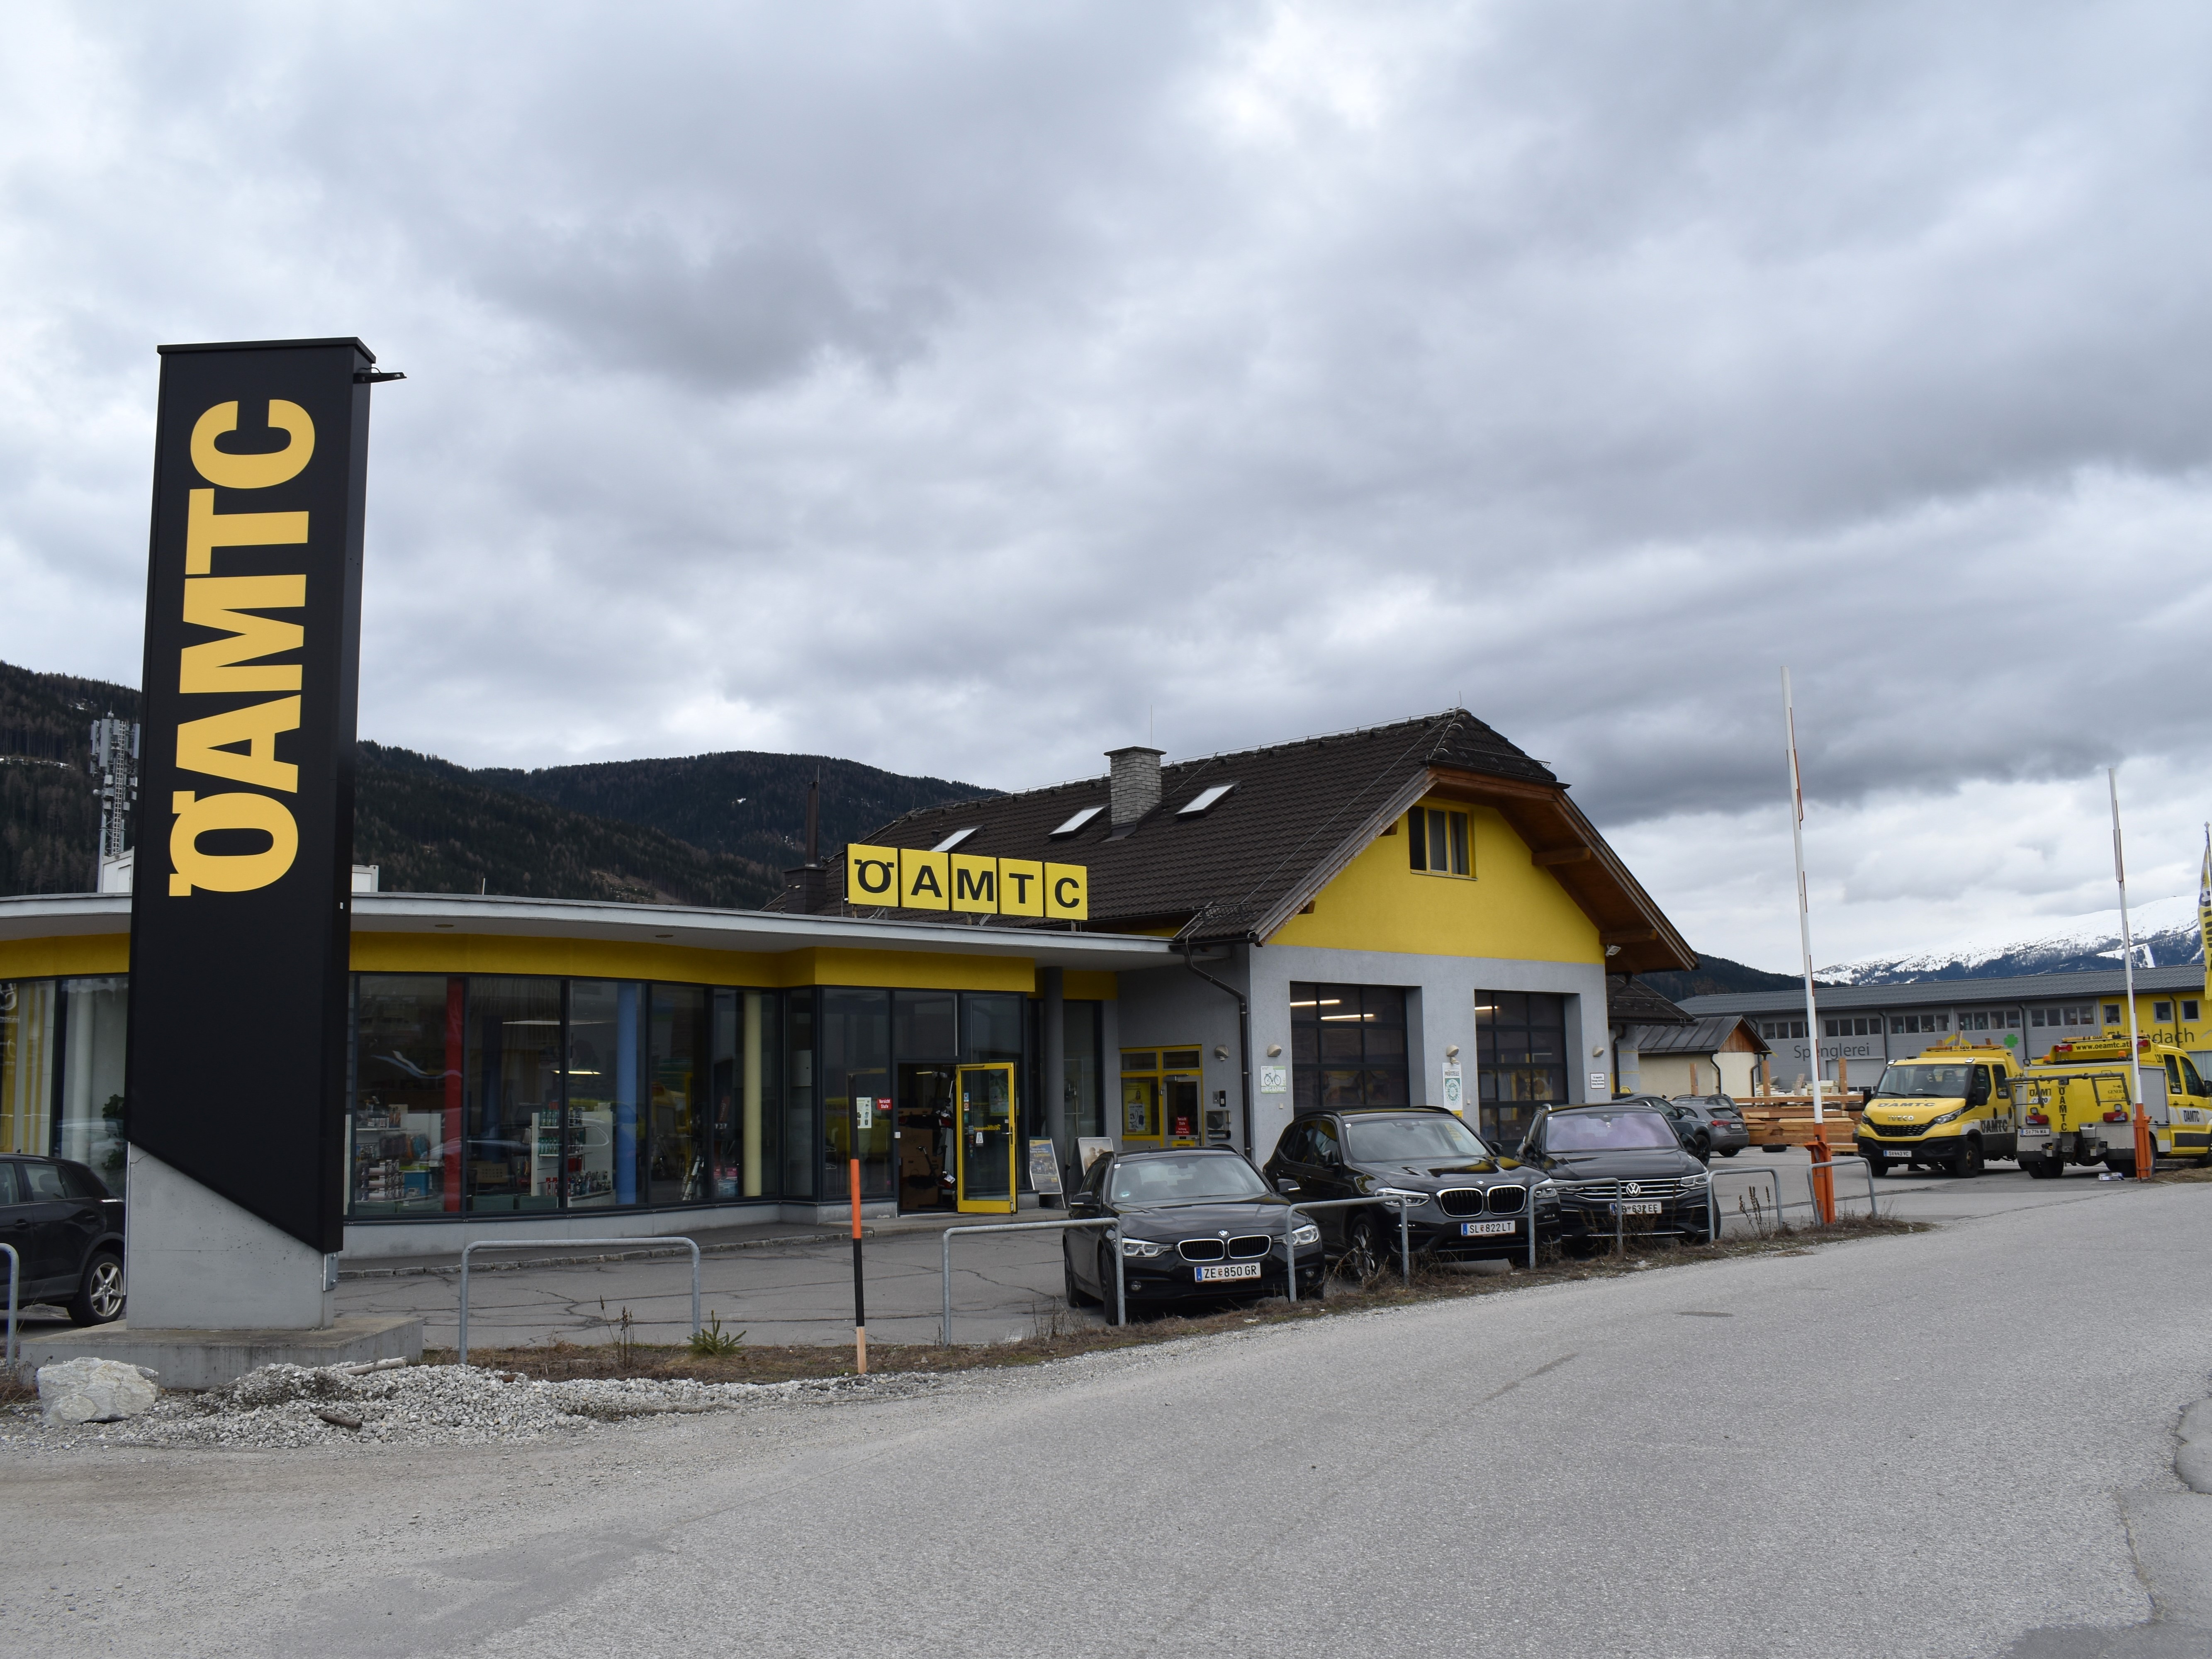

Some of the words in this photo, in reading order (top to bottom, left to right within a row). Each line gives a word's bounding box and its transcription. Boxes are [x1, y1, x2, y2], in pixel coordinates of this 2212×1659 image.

[169, 399, 315, 897] ÖAMTC
[854, 858, 1080, 908] ÖAMTC
[1794, 1042, 1869, 1061] Spnglerei
[2076, 1040, 2129, 1050] www.oeamtc.at
[2058, 1086, 2067, 1131] ÖAMTC
[2183, 1110, 2200, 1122] ÖAMTC
[1980, 1119, 2008, 1133] ÖAMTC
[1470, 1224, 1479, 1233] SL
[1204, 1268, 1216, 1278] ZE
[1224, 1266, 1242, 1277] 850
[1245, 1265, 1257, 1276] GR
